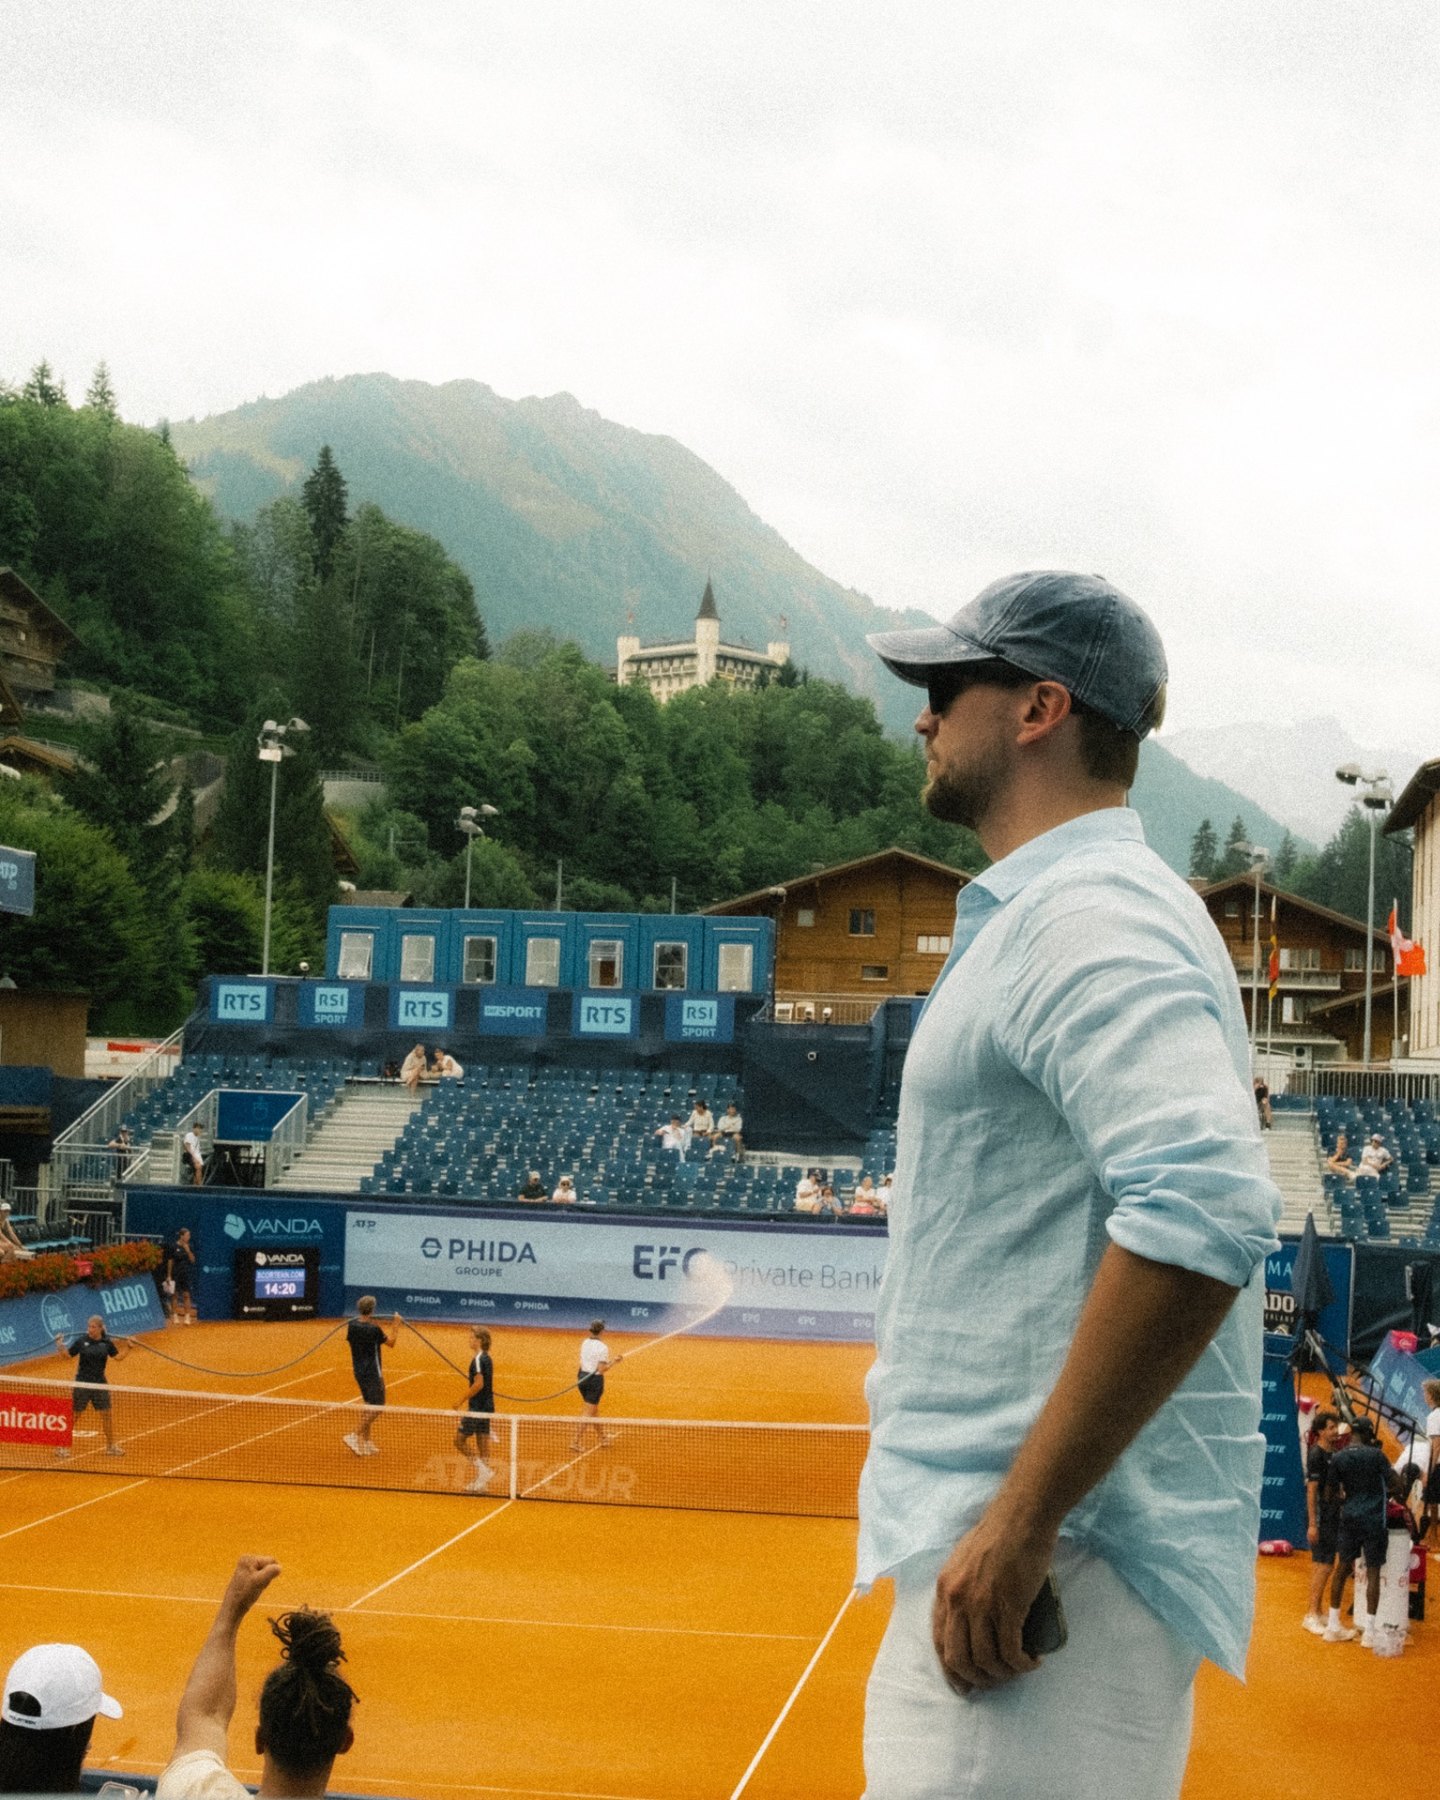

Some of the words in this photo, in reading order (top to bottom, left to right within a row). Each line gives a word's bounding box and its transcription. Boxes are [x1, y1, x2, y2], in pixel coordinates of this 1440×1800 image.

[223, 994, 261, 1011] RTS
[319, 994, 345, 1007] RSI
[404, 1001, 443, 1018] RTS
[587, 1007, 626, 1024] RTS
[687, 1007, 713, 1020] RSI
[315, 1015, 347, 1024] SPORT
[682, 1028, 717, 1037] SPORT
[247, 1218, 323, 1234] VANDA
[449, 1239, 537, 1264] PHIDA
[267, 1254, 305, 1263] VANDA
[455, 1266, 502, 1277] GROUPE
[821, 1263, 882, 1290] Bank
[264, 1283, 297, 1295] 14:20
[101, 1284, 148, 1314] RADO
[414, 1296, 441, 1305] PHIDA
[468, 1299, 495, 1308] PHIDA
[522, 1302, 549, 1311] PHIDA
[631, 1307, 649, 1317] EFG
